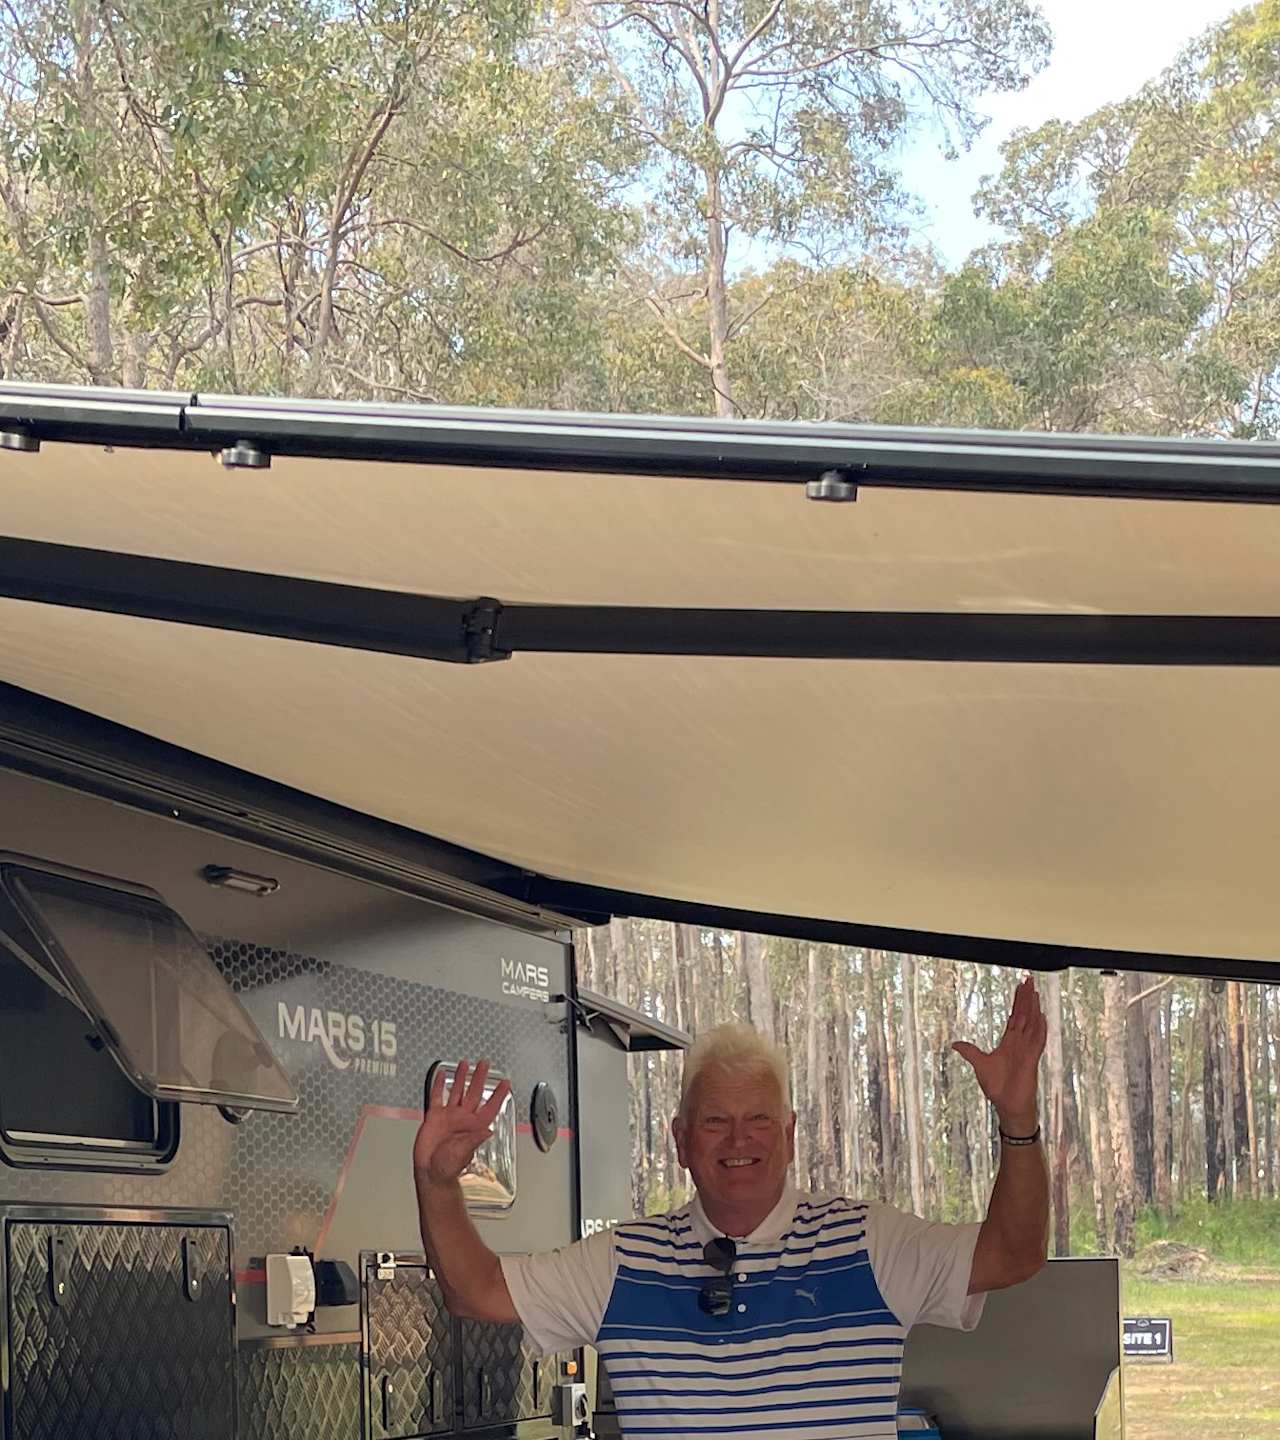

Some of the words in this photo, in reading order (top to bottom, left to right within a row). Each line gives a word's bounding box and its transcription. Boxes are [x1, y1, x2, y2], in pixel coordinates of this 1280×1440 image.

[501, 957, 549, 987] MARS
[278, 1002, 365, 1068] MARS
[371, 1019, 398, 1056] 15
[1122, 1332, 1152, 1345] SITE
[1154, 1331, 1162, 1345] 1
